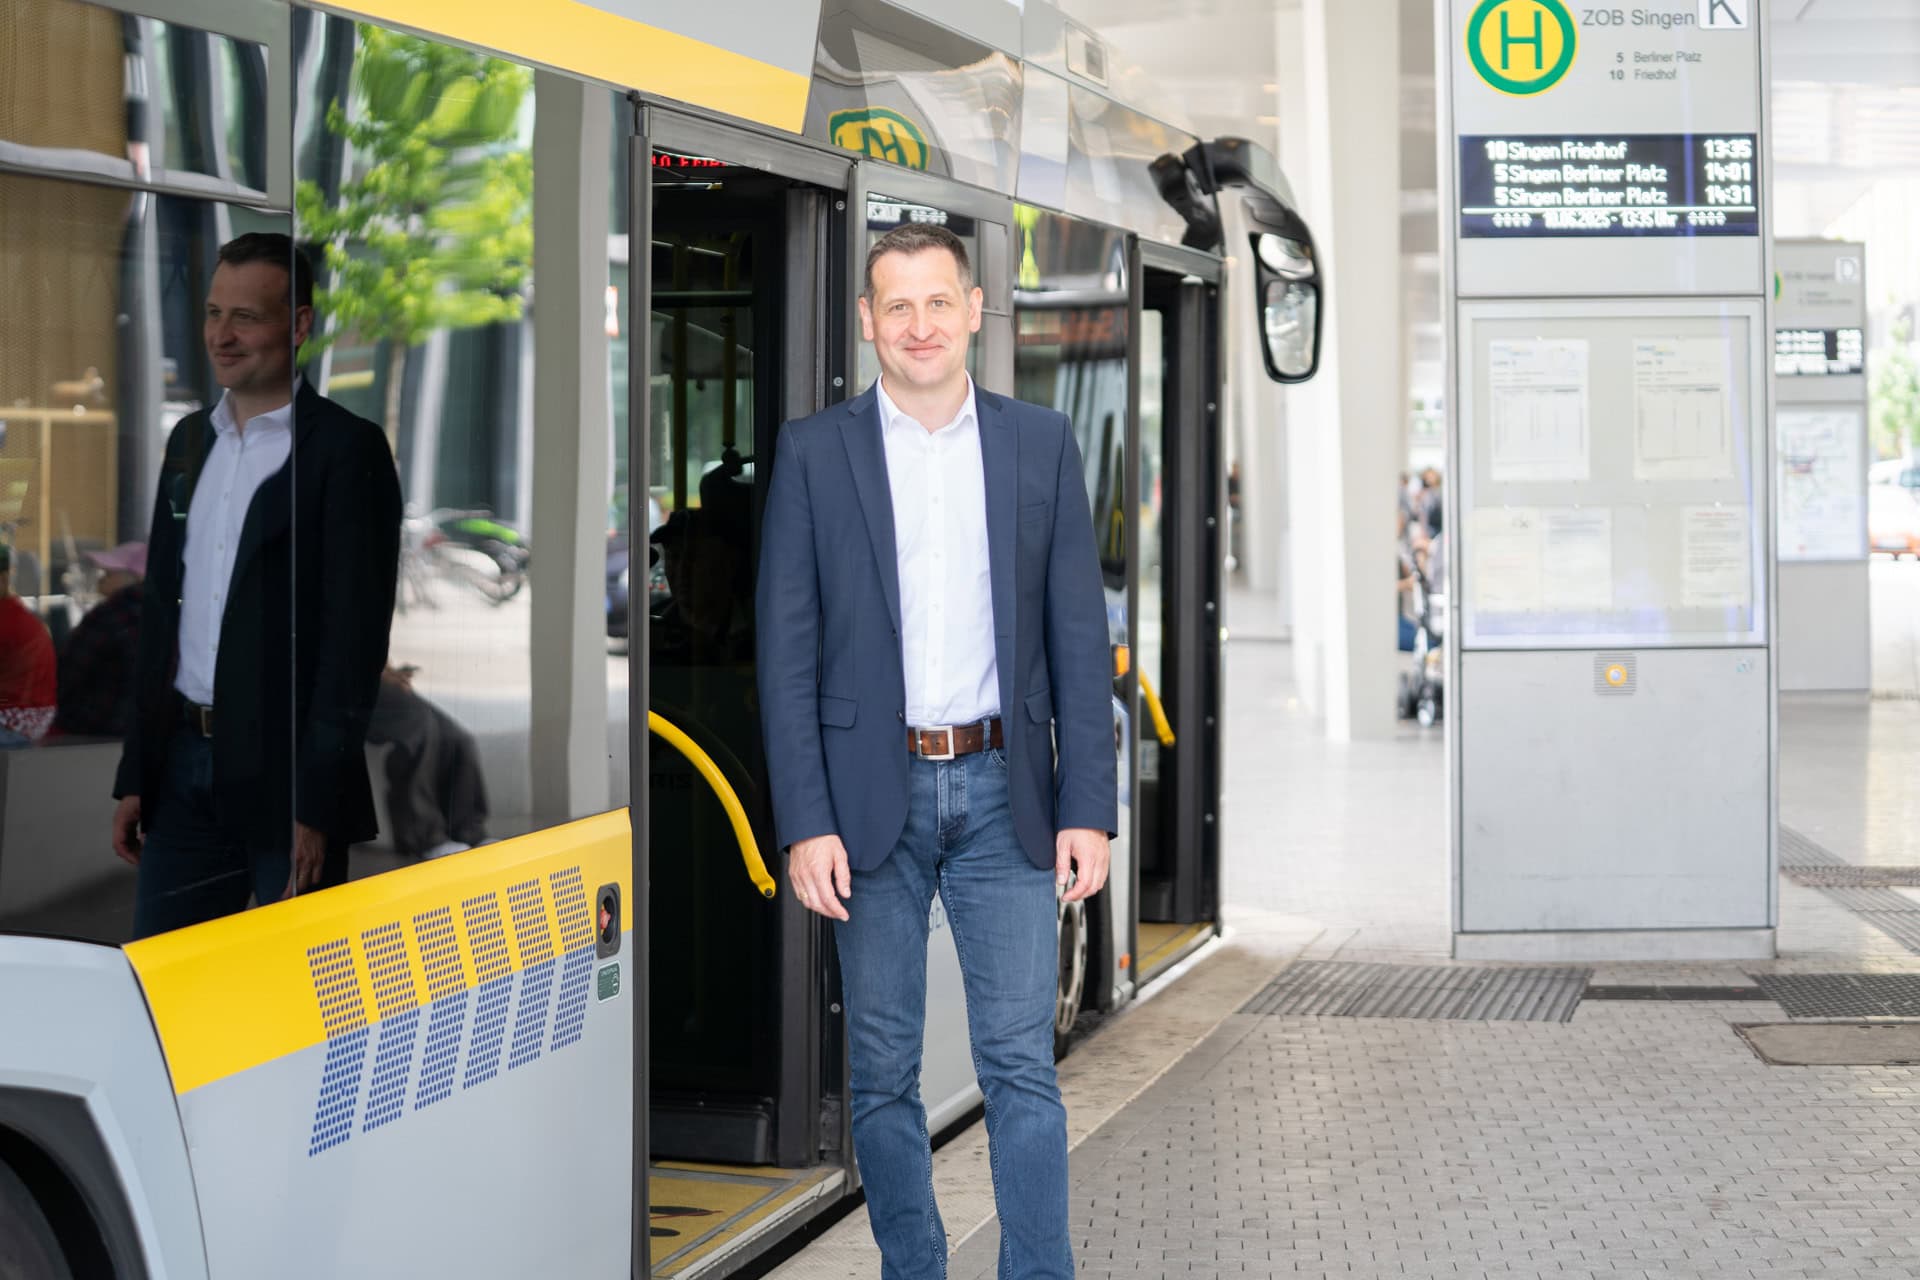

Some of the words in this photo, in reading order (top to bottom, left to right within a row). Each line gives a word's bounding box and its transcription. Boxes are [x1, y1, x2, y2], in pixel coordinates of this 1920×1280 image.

[1581, 9, 1625, 26] ZOB
[1631, 9, 1695, 30] Singen
[1500, 10, 1543, 70] H
[1616, 52, 1625, 63] 5
[1634, 51, 1673, 63] Berliner
[1676, 51, 1702, 63] Platz
[1610, 69, 1625, 80] 10
[1634, 68, 1677, 80] Friedhof
[1509, 142, 1561, 162] Singen
[1562, 141, 1627, 160] Friedhof
[1494, 163, 1508, 183] 5
[1509, 165, 1562, 184] Singen
[1562, 164, 1624, 183] Berliner
[1625, 164, 1667, 183] Platz
[1494, 186, 1509, 206] 5
[1509, 188, 1562, 207] Singen
[1562, 187, 1624, 206] Berliner
[1626, 187, 1668, 205] Platz
